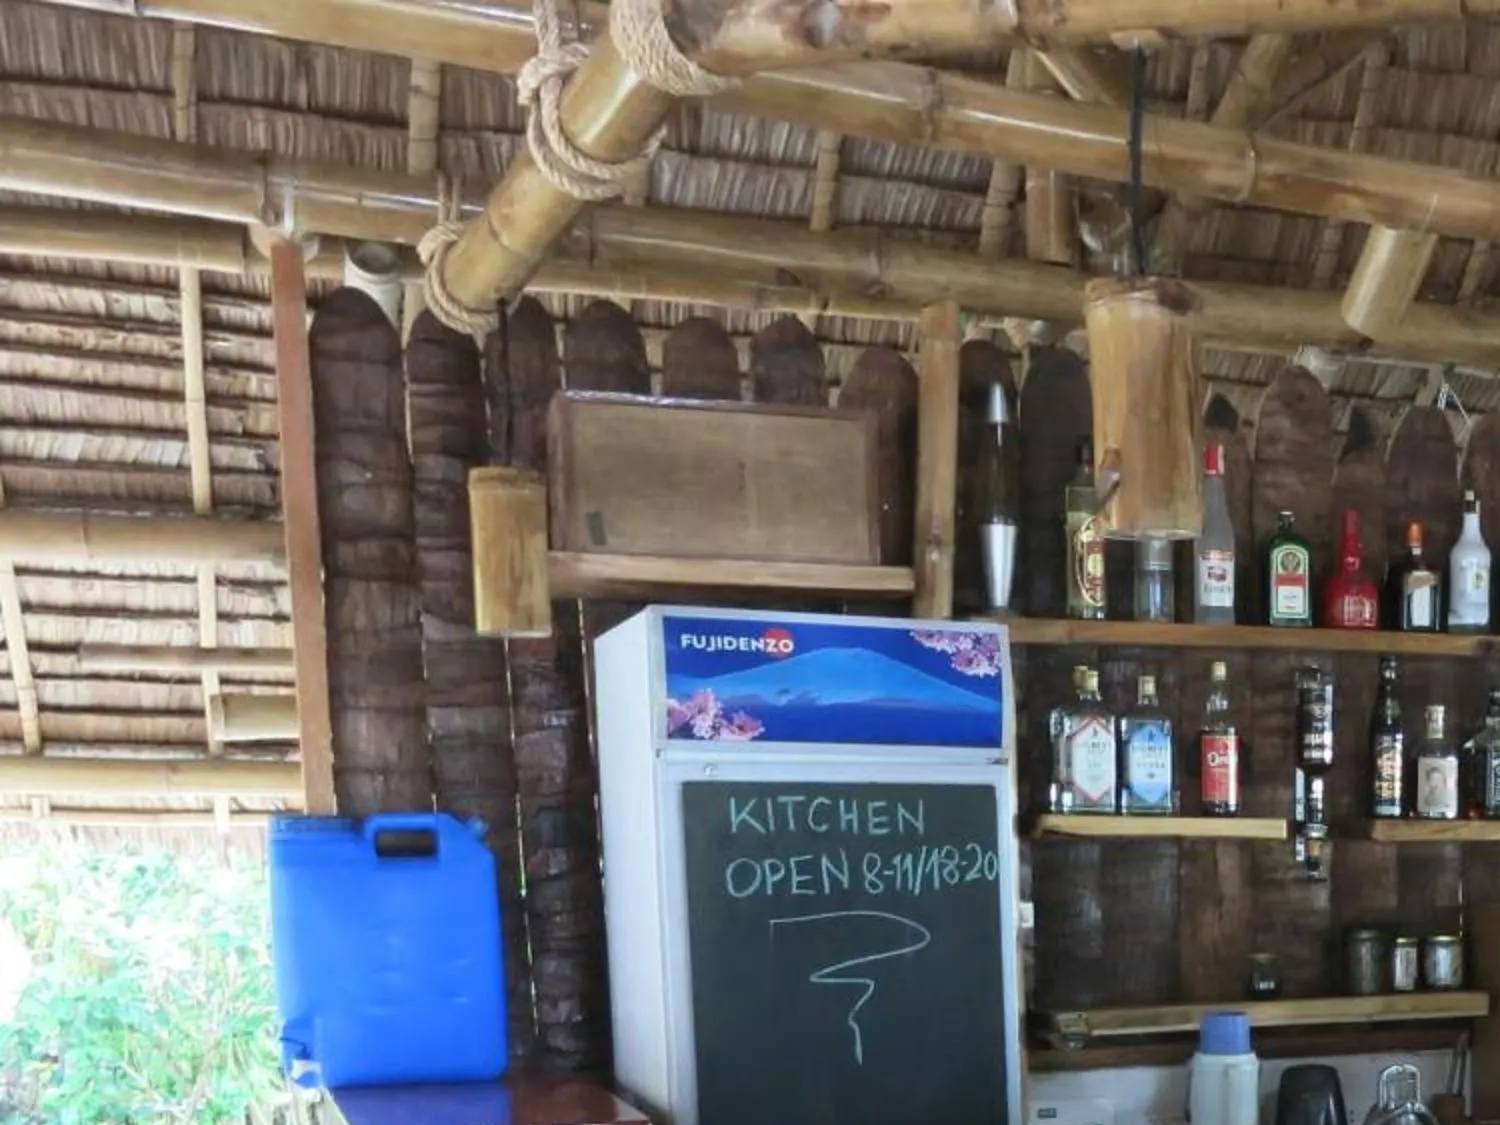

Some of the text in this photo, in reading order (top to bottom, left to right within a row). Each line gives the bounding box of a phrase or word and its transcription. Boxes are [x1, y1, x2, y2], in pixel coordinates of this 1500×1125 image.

[681, 633, 794, 653] FUJIDENZO
[729, 795, 924, 835] KITCHEN
[725, 848, 849, 897] OPEN
